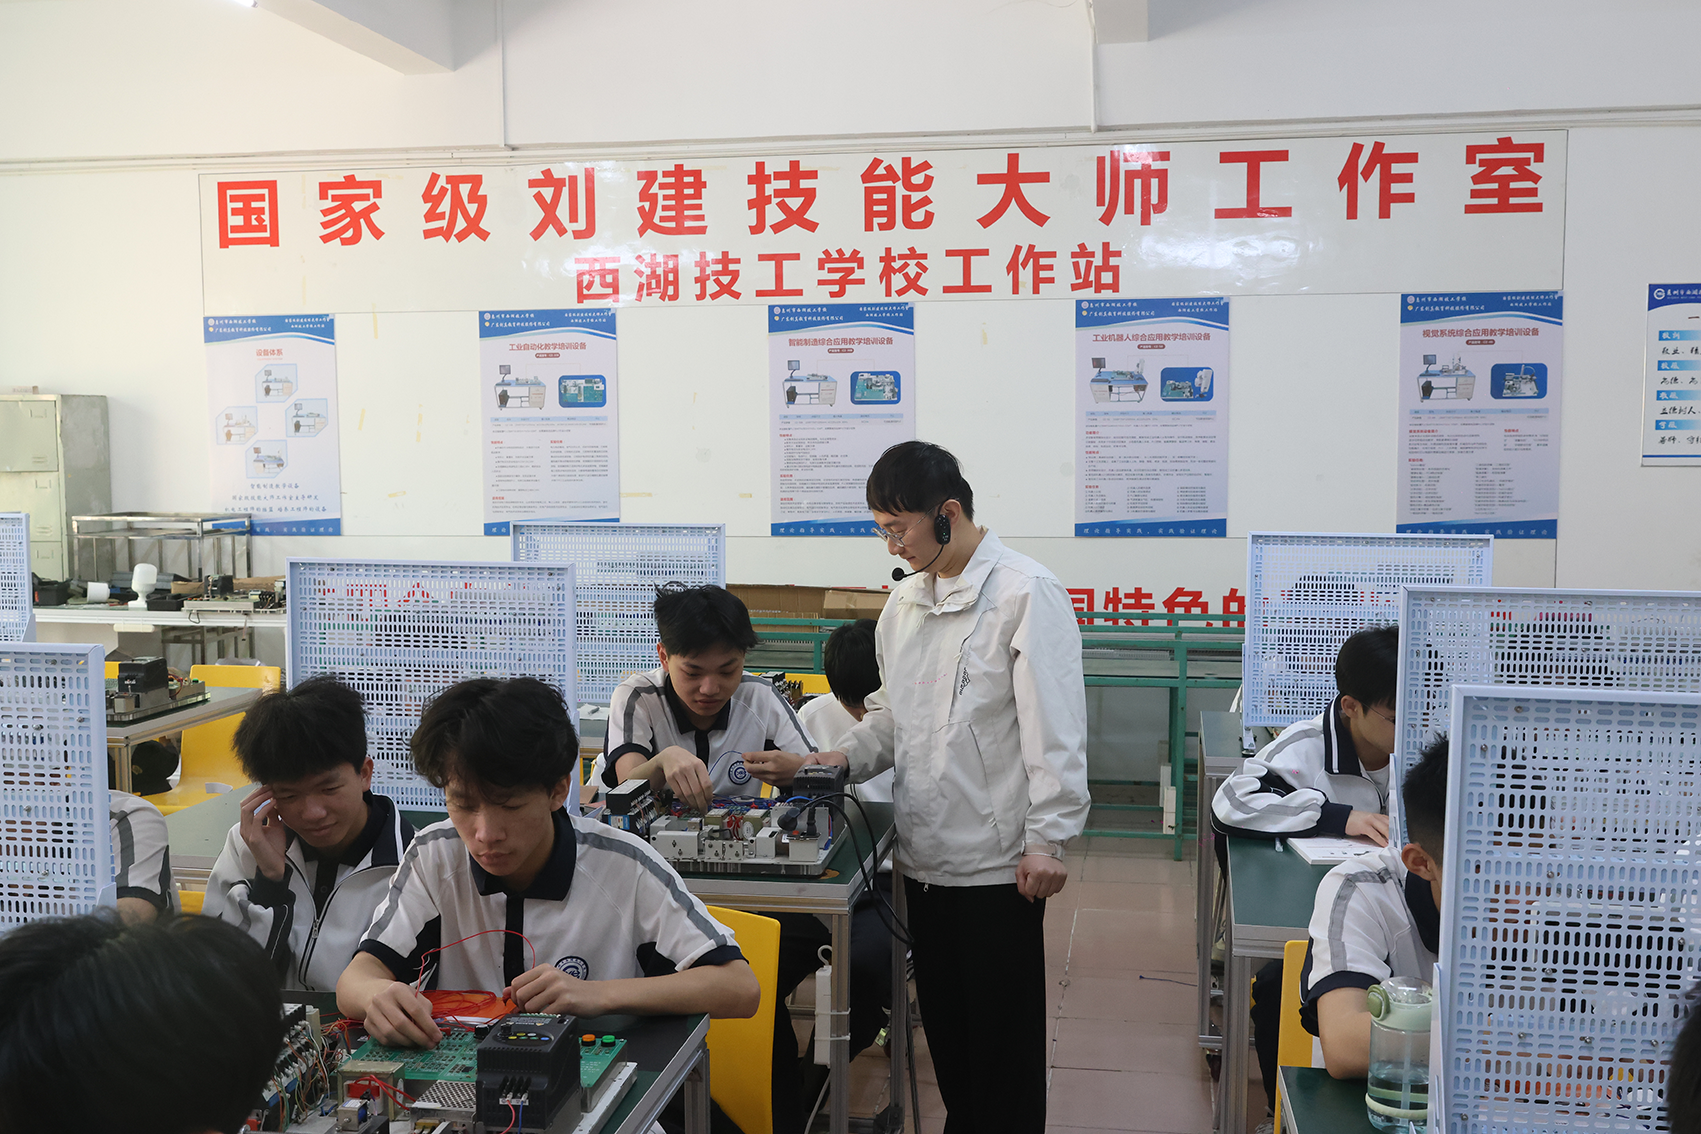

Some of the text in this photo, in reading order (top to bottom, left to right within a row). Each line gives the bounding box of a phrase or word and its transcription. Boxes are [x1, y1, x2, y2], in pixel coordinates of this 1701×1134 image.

[217, 137, 1544, 249] 国家级刘建技能大师工作室
[574, 242, 1122, 304] 西湖技工学校工作站
[1092, 332, 1211, 342] 工业机器人综合应用教学培训设备
[1422, 327, 1539, 338] 视觉系统综合应用教学培训设备
[788, 336, 893, 346] 智能制造综合应用教学培训设备
[509, 342, 587, 351] 工业自动化教学培训设备
[1661, 345, 1701, 355] 敬业、精
[256, 348, 283, 357] 设备体系
